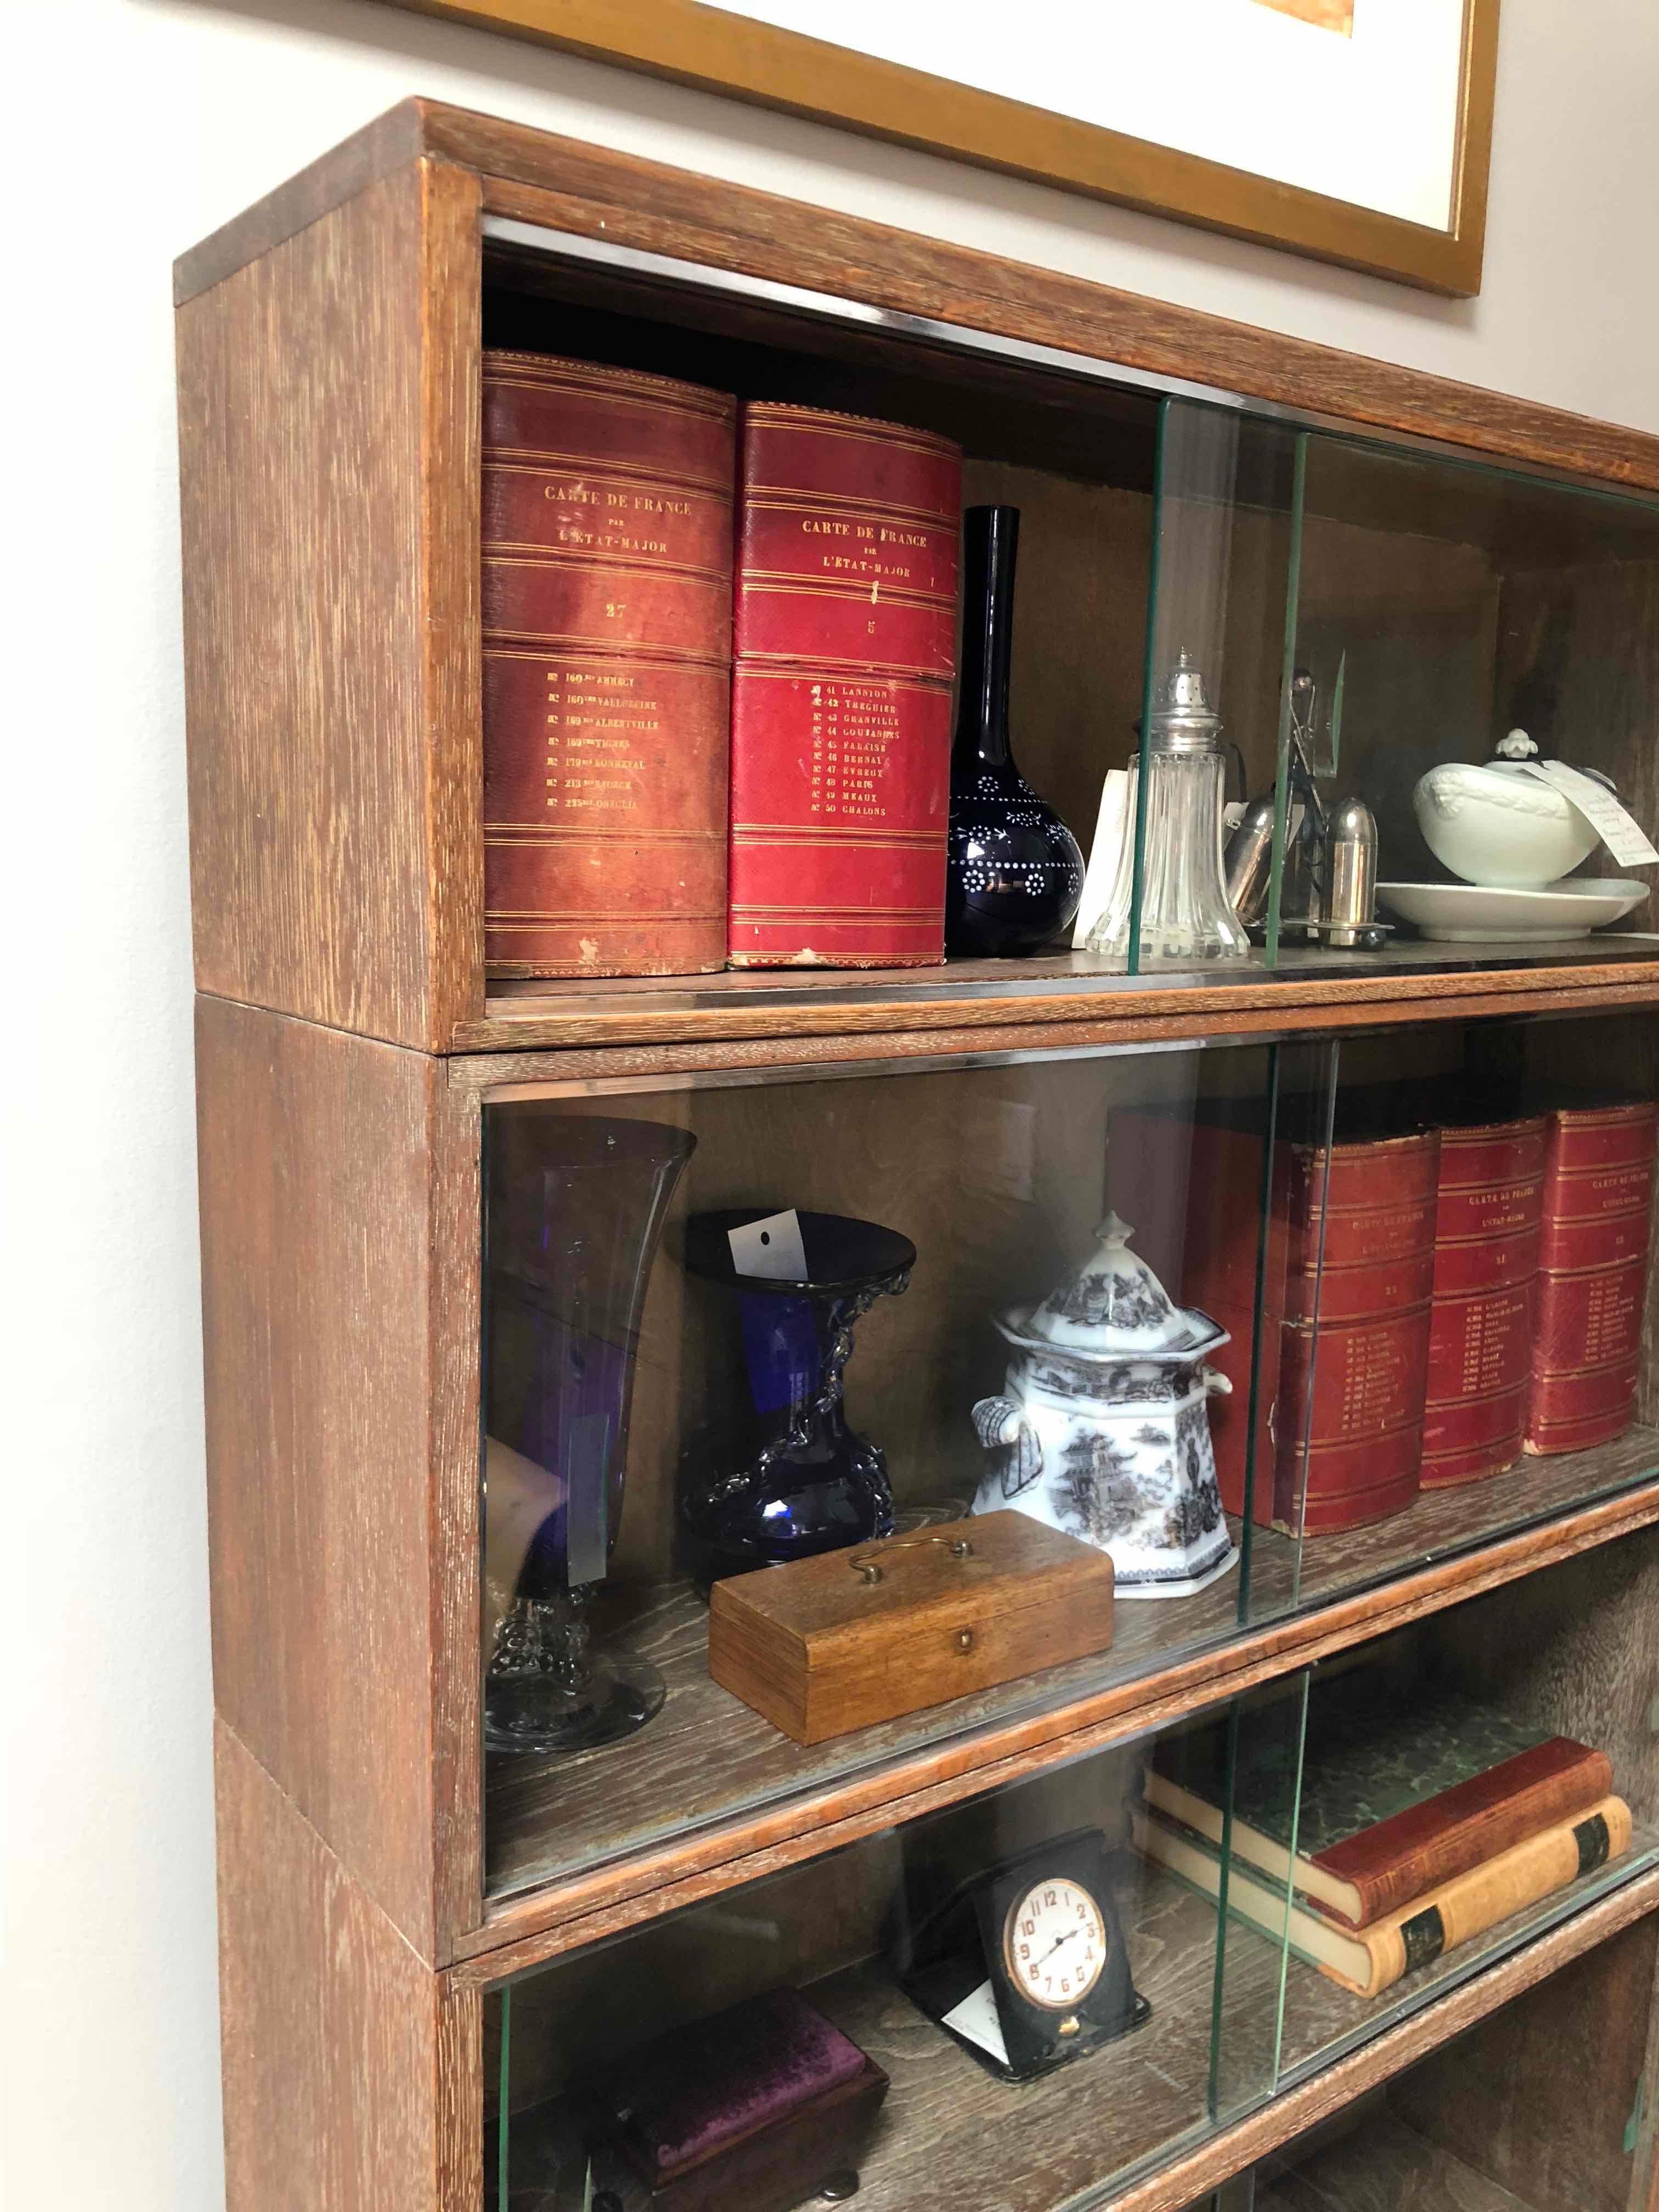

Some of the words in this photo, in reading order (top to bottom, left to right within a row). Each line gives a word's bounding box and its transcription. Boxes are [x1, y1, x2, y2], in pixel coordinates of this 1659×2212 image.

[544, 486, 600, 505] CARTE
[607, 493, 628, 508] DE
[634, 496, 692, 515] FRANCE
[802, 520, 850, 535] CARTE
[856, 526, 874, 539] DE
[880, 528, 927, 548] FRANCE
[606, 603, 627, 618] 27
[867, 620, 876, 634] 5
[827, 699, 839, 707] 42
[843, 715, 899, 726] GRANVILLE
[827, 726, 837, 735] 44
[827, 740, 837, 749] 45
[843, 741, 887, 752] FALAISE
[827, 752, 837, 761] 46
[827, 765, 836, 774] 47
[826, 778, 836, 786] 48
[843, 780, 873, 789] PARIS
[826, 791, 836, 799] 49
[842, 792, 877, 803] MEAUX
[825, 804, 836, 812] 50
[842, 805, 887, 816] CHALONS
[1045, 1891, 1057, 1907] 12
[1065, 1892, 1069, 1906] 1
[1031, 1900, 1041, 1916] 11
[1076, 1903, 1086, 1919] 2
[1021, 1920, 1035, 1937] 10
[1086, 1922, 1095, 1938] 3
[1020, 1944, 1030, 1959] 9
[1085, 1946, 1093, 1961] 4
[1029, 1964, 1040, 1980] 8
[1076, 1966, 1085, 1982] 5
[1045, 1977, 1052, 1993] 7
[1061, 1978, 1069, 1993] 6
